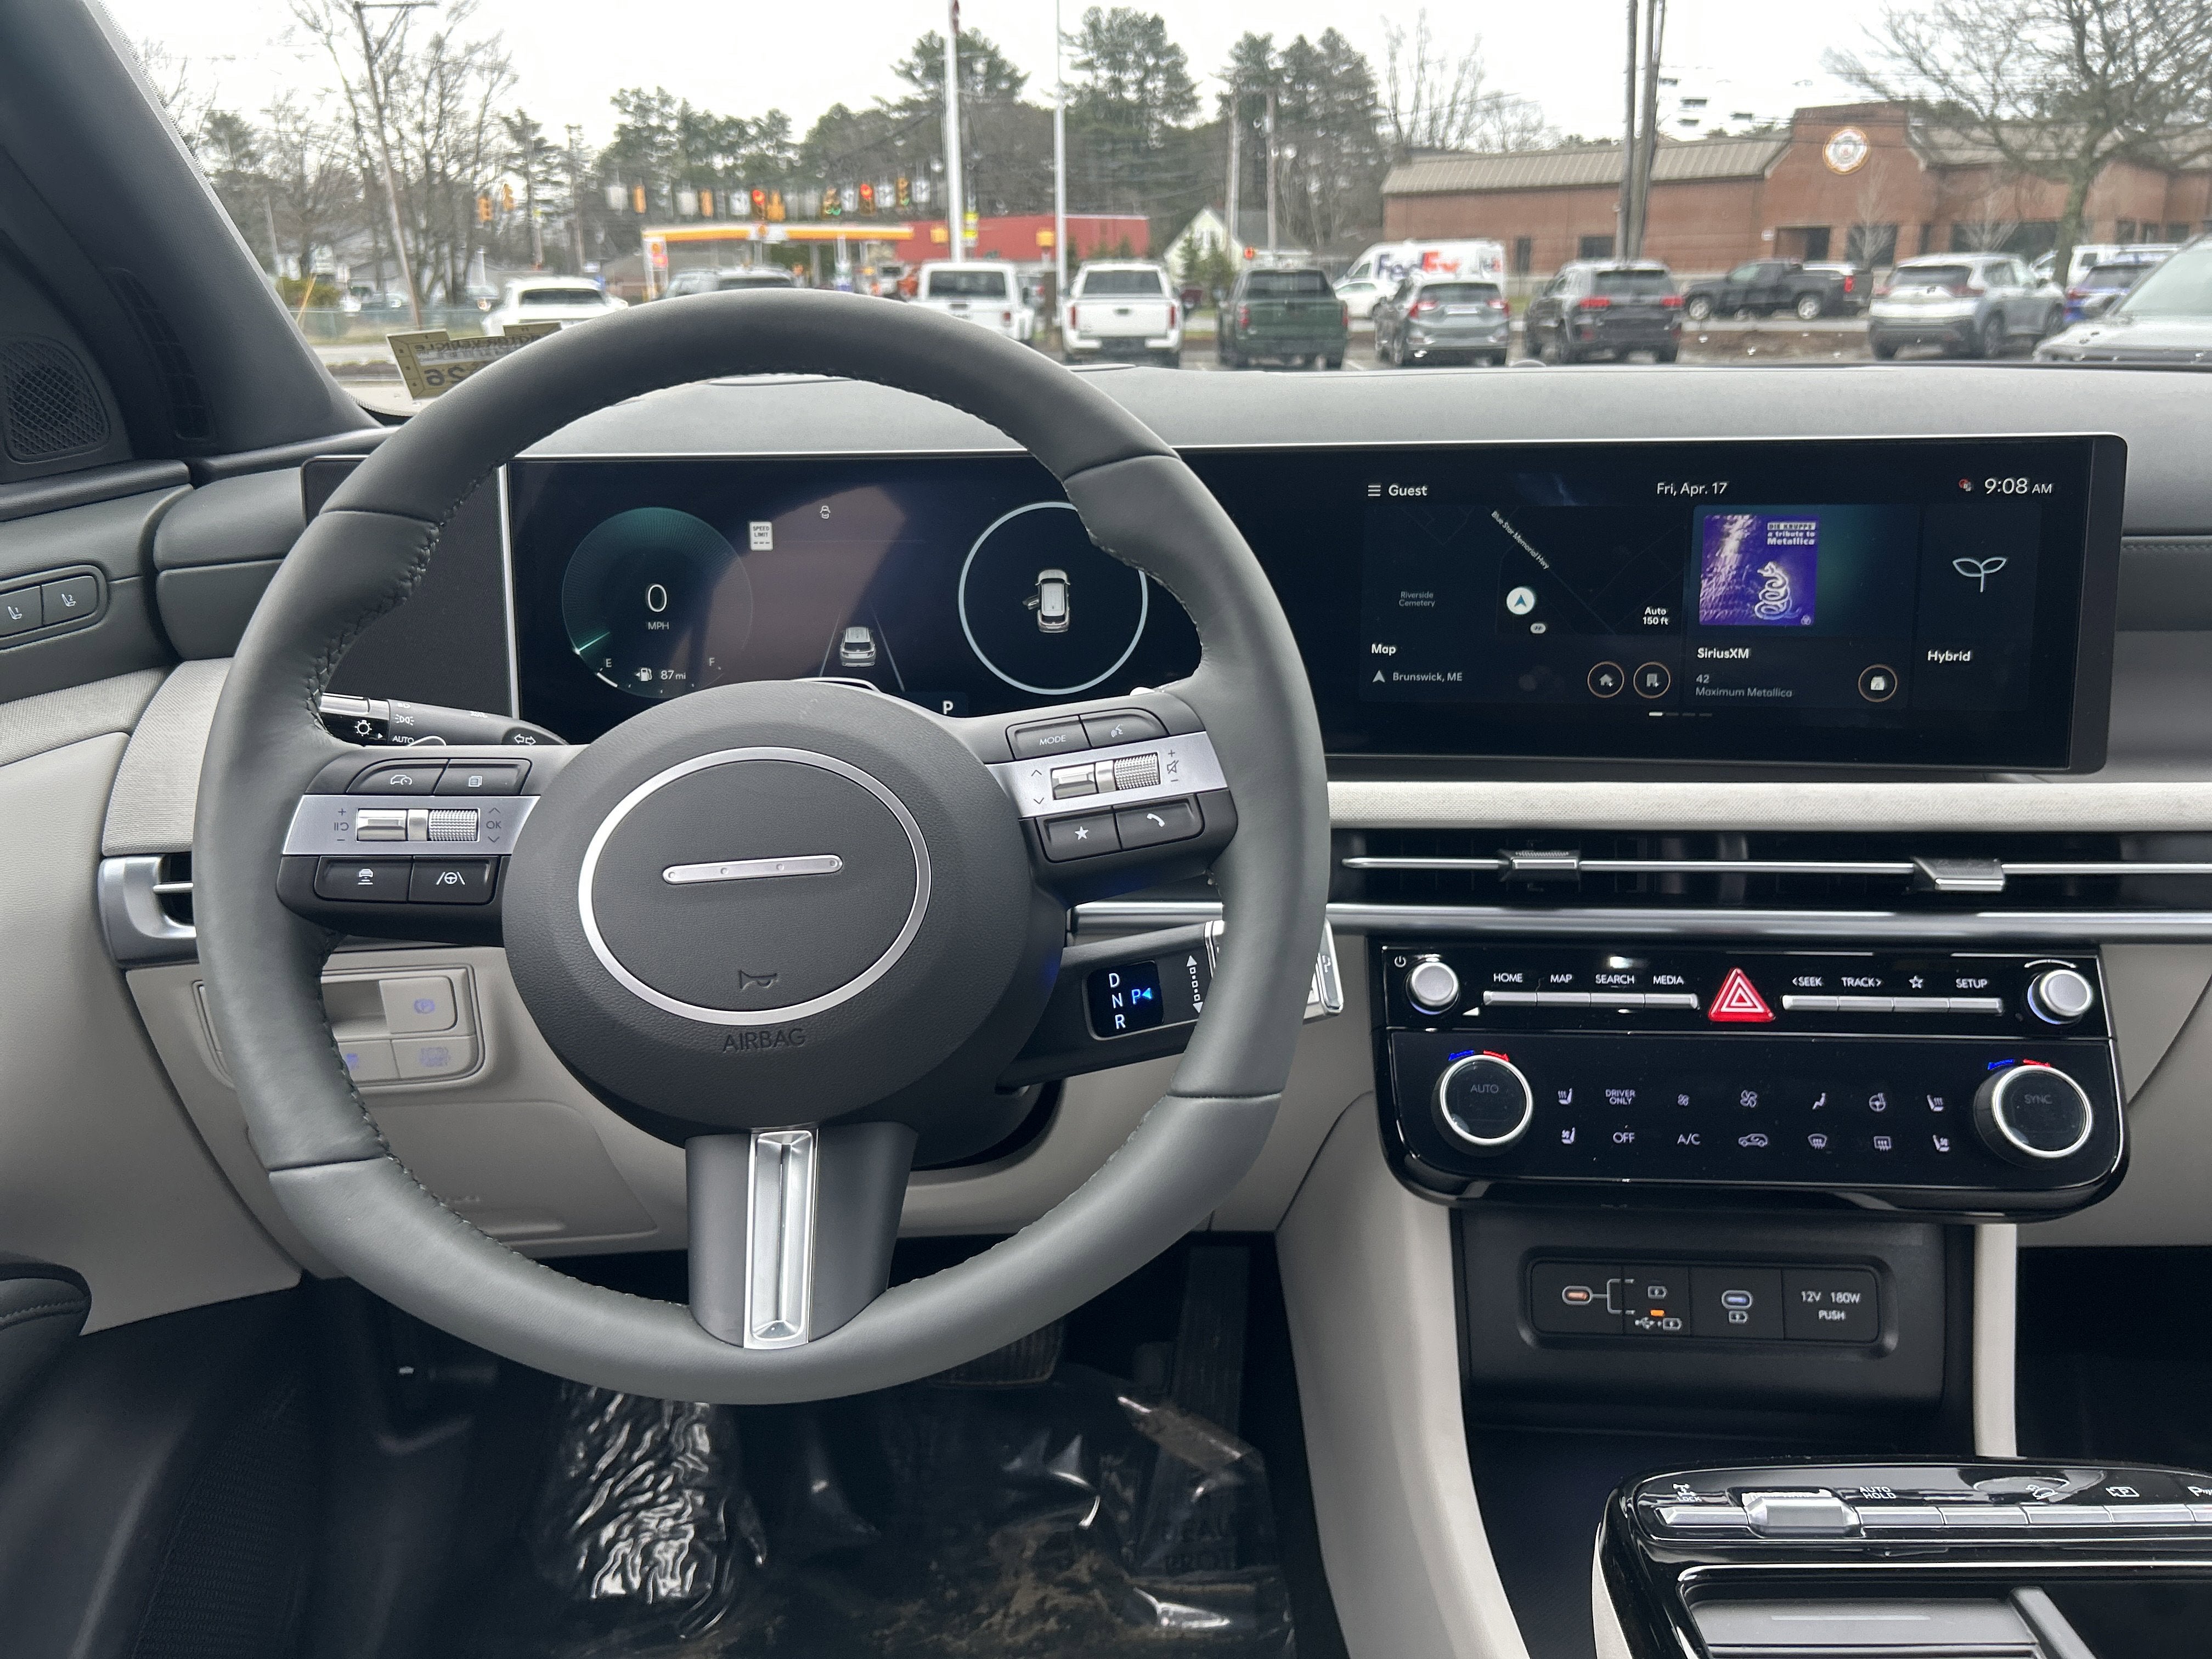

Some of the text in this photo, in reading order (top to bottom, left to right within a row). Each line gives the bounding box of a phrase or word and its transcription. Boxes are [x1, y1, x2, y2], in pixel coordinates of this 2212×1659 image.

[1388, 484, 1427, 496] Guest
[1657, 482, 1728, 496] Fri, Apr. 17
[1985, 478, 2052, 494] 9:08 AM
[1491, 511, 1549, 569] Blue Star Memorial Hwy
[647, 584, 667, 612] 0
[1399, 599, 1436, 607] Cemetery
[1644, 606, 1667, 615] Auto
[648, 621, 669, 630] MPH
[1643, 617, 1669, 625] 150 ft
[1372, 644, 1396, 656] Map
[1697, 647, 1750, 659] SiriusXM
[709, 658, 715, 667] F
[1927, 650, 1971, 664] Hybrid
[606, 658, 612, 668] E
[660, 670, 674, 680] 87
[1393, 673, 1463, 682] Brunswick, ME
[1696, 674, 1710, 684] 42
[1696, 687, 1793, 698] Maximum Metallica
[943, 700, 953, 714] P
[392, 736, 414, 744] AUTO
[1039, 734, 1066, 746] MODE
[486, 820, 501, 830] OK
[1108, 973, 1120, 988] D
[1493, 973, 1523, 983] HOME
[1550, 974, 1573, 984] MAP
[1595, 974, 1634, 984] SEARCH
[1652, 975, 1685, 985] MEDIA
[1955, 978, 1989, 989] SETUP
[1112, 993, 1124, 1008] N
[1131, 989, 1142, 1005] P
[1115, 1014, 1126, 1029] R
[723, 1028, 806, 1053] AIRBAG
[1470, 1084, 1499, 1094] AUTO
[1605, 1089, 1635, 1097] DRIVER
[1609, 1097, 1632, 1105] ONLY
[2024, 1094, 2052, 1104] SYNC
[1612, 1131, 1635, 1144] OFF
[1677, 1133, 1700, 1145] A/C
[1801, 1290, 1861, 1304] 12V 180W
[1819, 1310, 1846, 1321] PUSH
